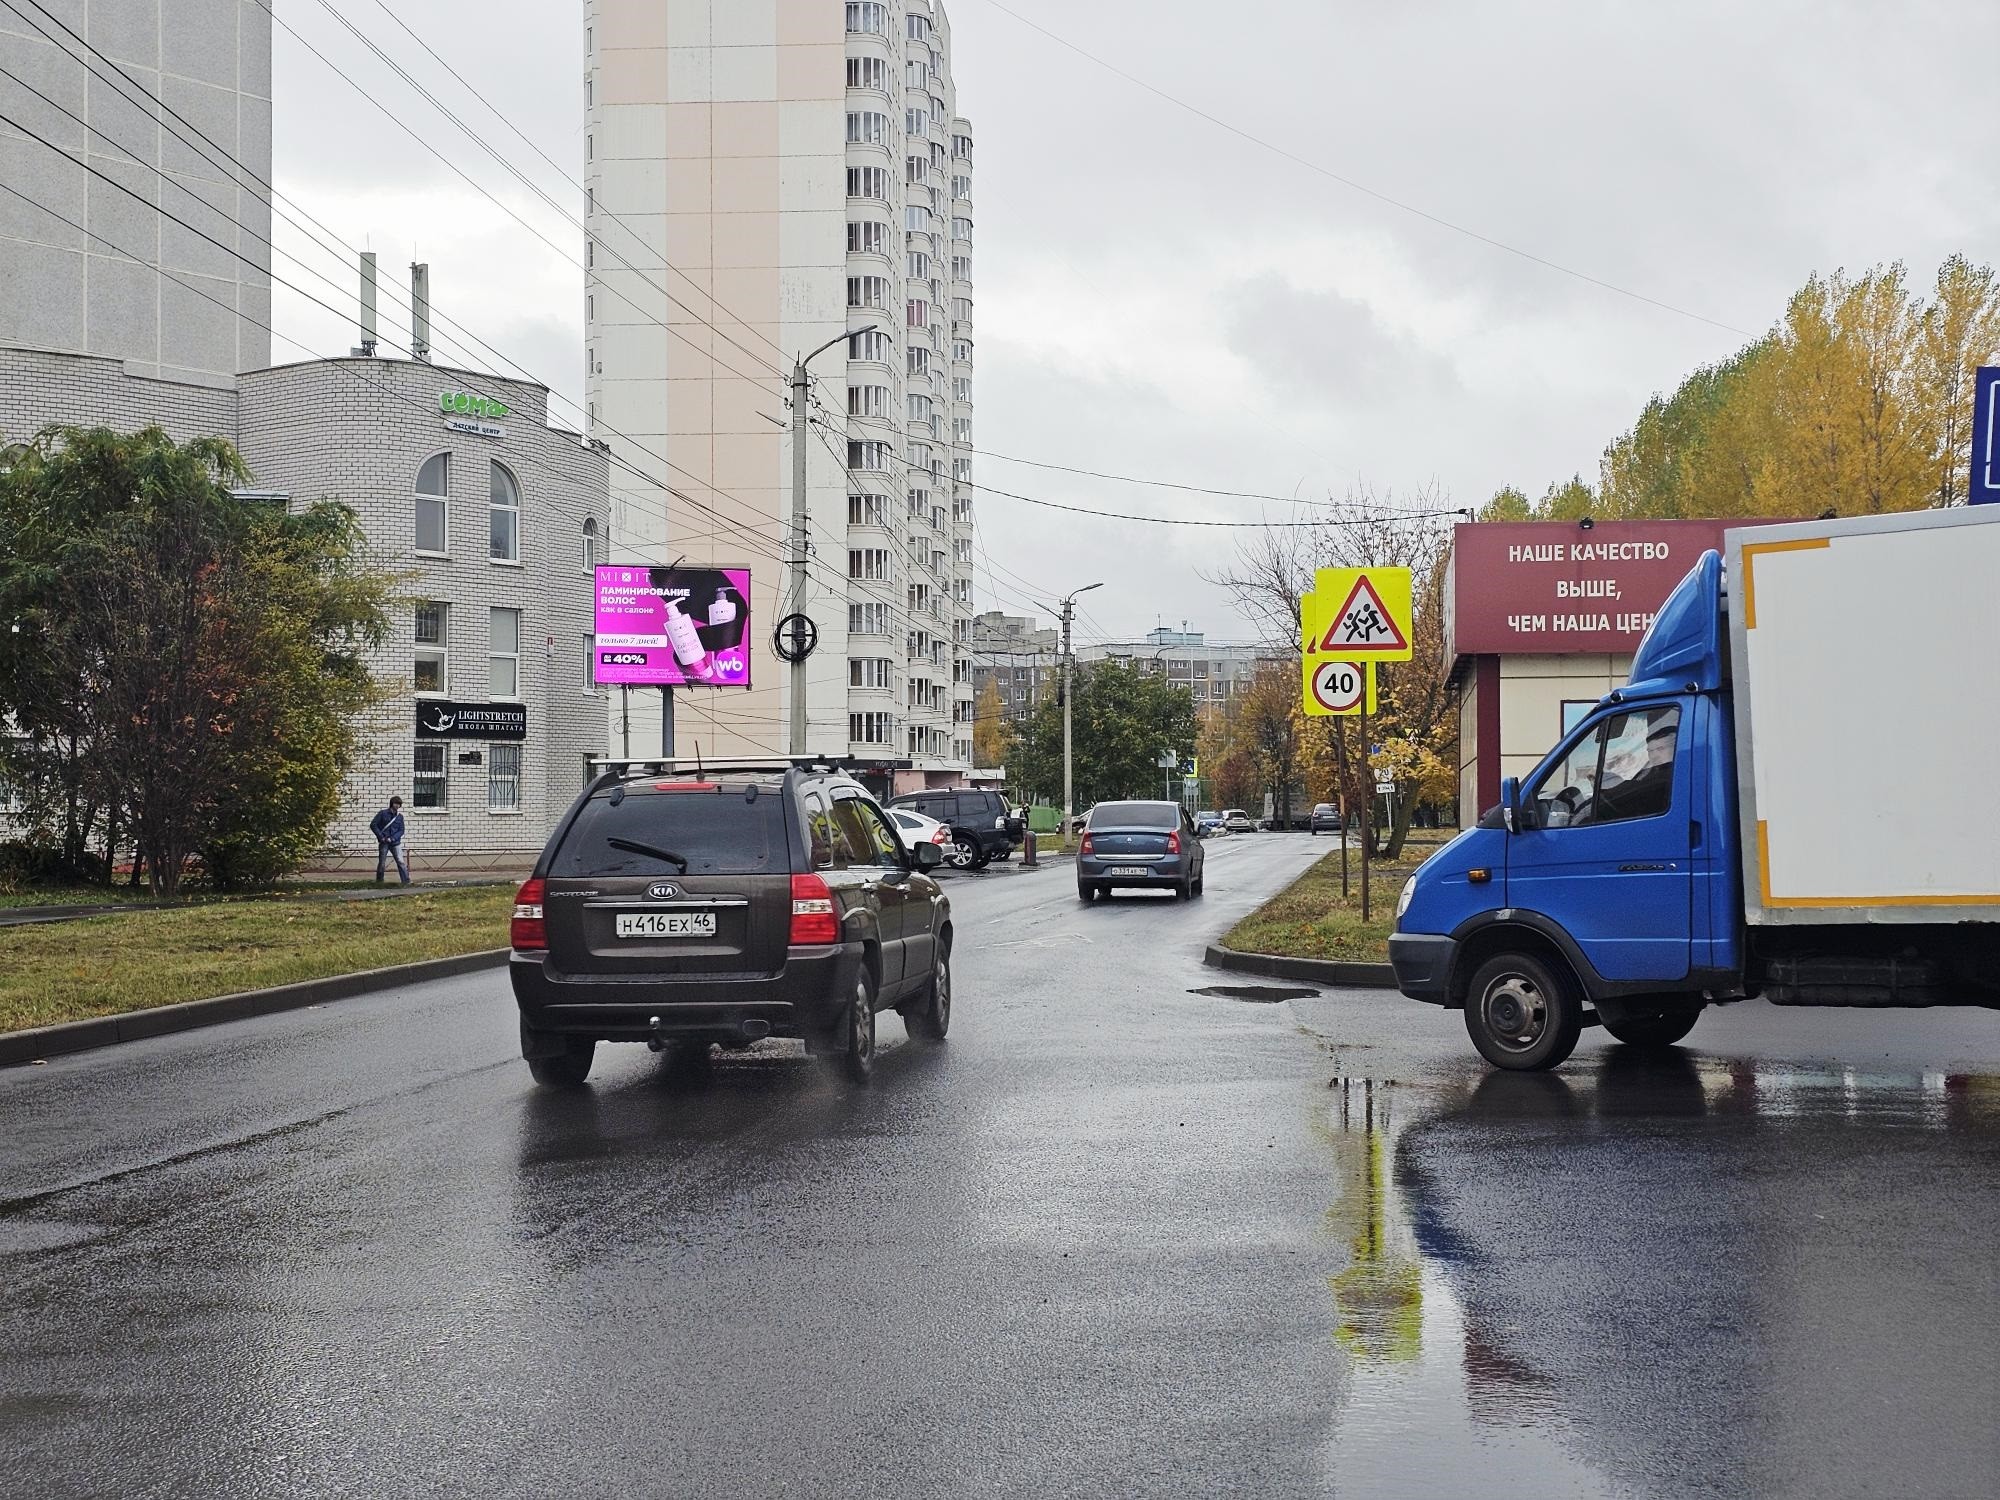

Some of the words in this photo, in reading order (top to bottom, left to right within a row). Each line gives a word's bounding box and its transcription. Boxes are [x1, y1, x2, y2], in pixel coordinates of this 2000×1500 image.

[1509, 544, 1564, 562] НАШЕ
[1570, 542, 1670, 561] КАЧЕСТВО
[600, 586, 691, 597] ЛАМИНИРОВАНИЕ
[1556, 580, 1622, 601] ВЫШЕ,
[600, 596, 636, 605] ВОЛОС
[1507, 614, 1546, 632] ЧЕМ
[1552, 614, 1611, 632] НАША
[718, 656, 743, 672] wb
[1324, 673, 1354, 694] 40
[458, 710, 524, 722] LIGHTSTRETCH
[653, 887, 673, 896] KIA
[694, 914, 710, 928] 46
